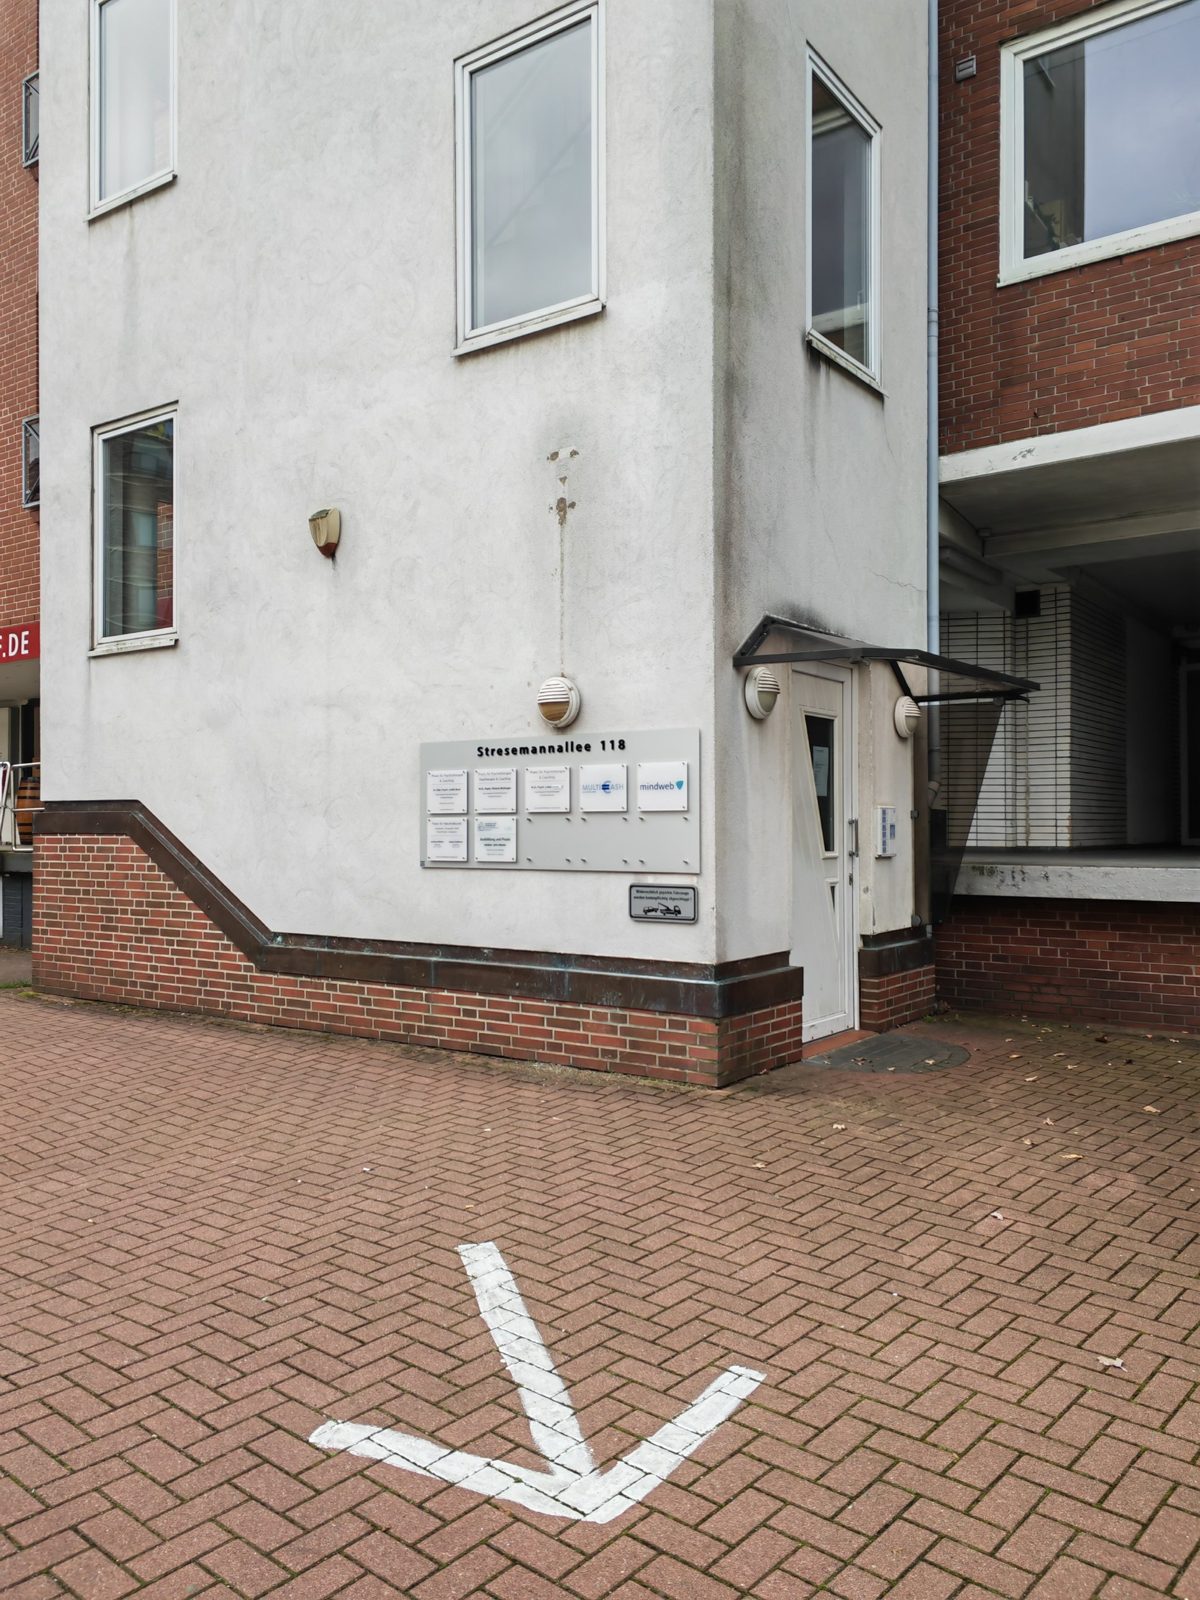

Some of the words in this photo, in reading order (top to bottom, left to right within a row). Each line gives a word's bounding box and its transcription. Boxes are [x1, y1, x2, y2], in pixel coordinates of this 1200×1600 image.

[477, 741, 592, 757] Stresemannallee
[600, 739, 626, 751] 118
[640, 782, 675, 791] mindweb
